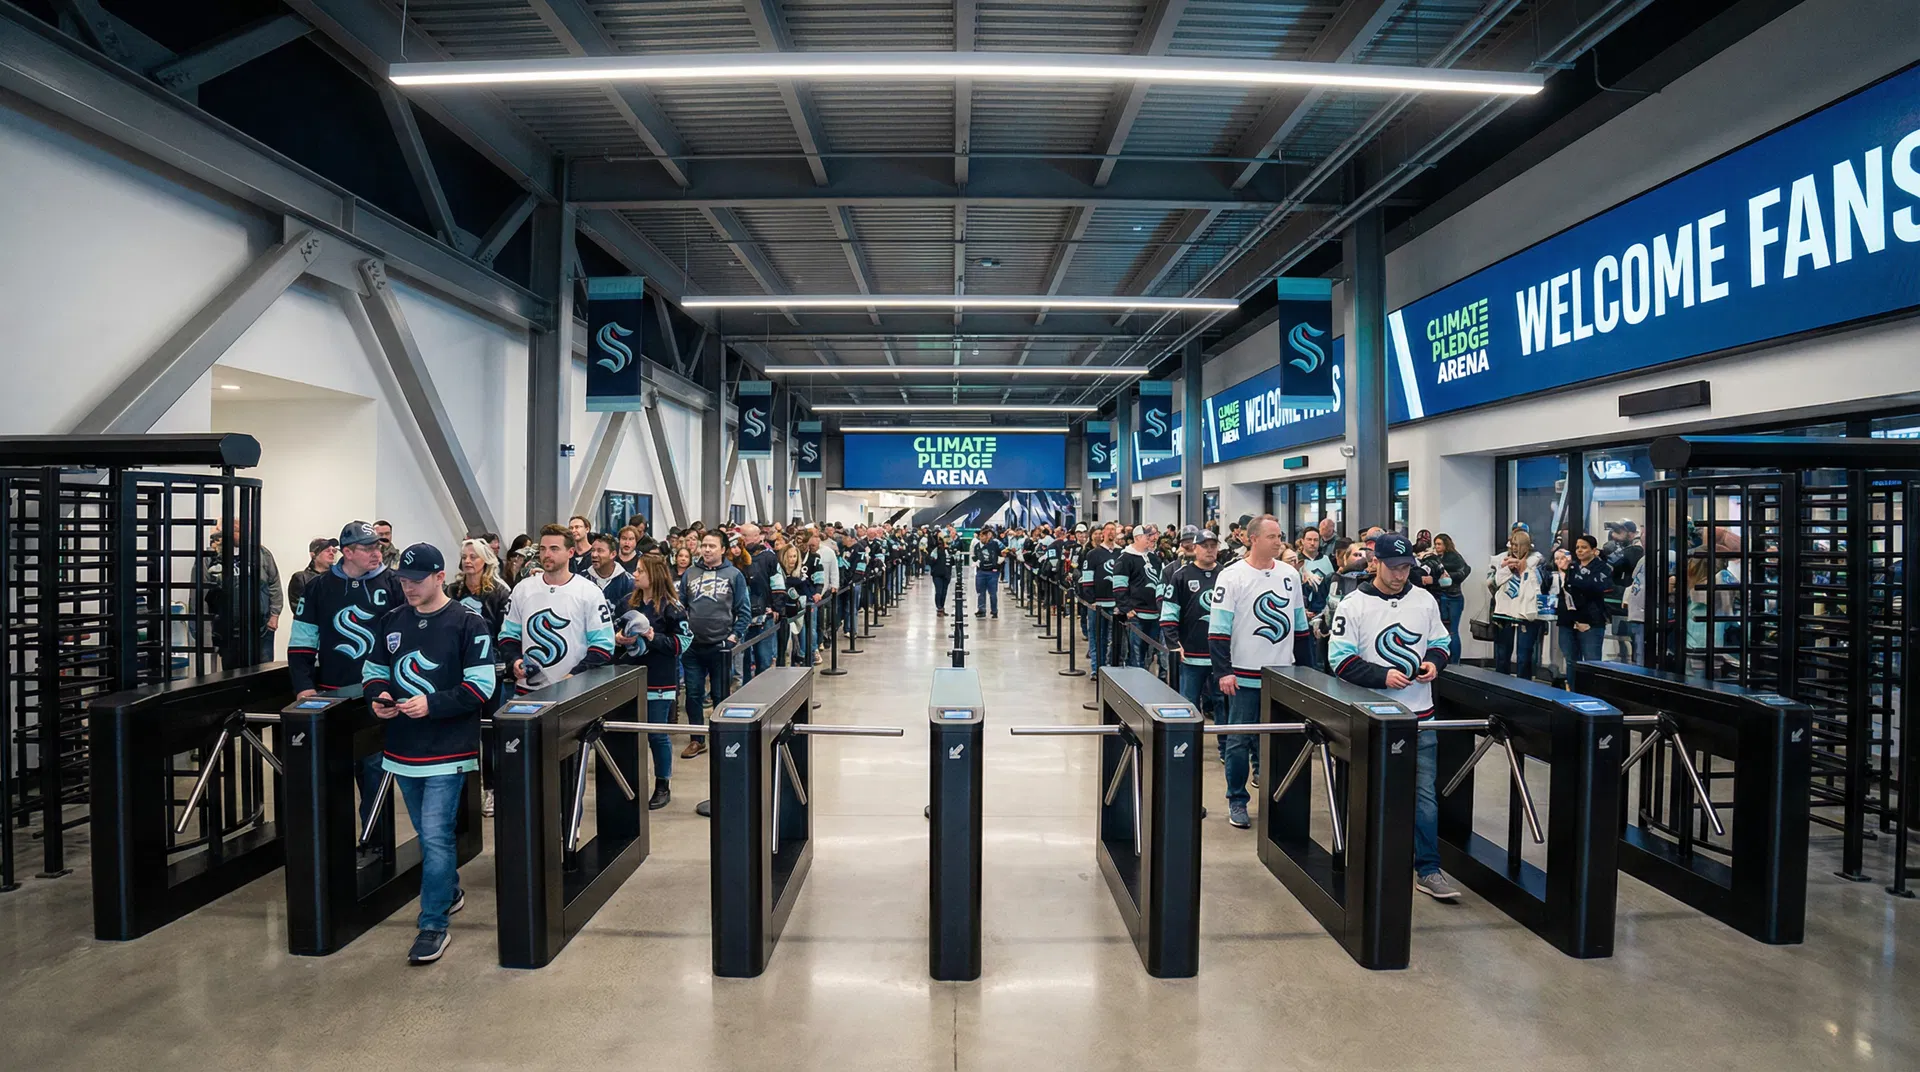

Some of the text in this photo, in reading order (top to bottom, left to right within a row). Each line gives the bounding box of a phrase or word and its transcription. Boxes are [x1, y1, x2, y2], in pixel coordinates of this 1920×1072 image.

[1515, 208, 1729, 356] WELCOME
[1426, 297, 1488, 342] CLIMATE
[1432, 322, 1489, 363] PLEDGE
[1437, 348, 1490, 385] ARENA
[913, 436, 997, 453] CLIMATE
[918, 452, 993, 469] PLEDGE
[921, 469, 989, 485] ARENA
[1283, 577, 1293, 592] C
[373, 588, 387, 606] C
[474, 634, 491, 660] 7
